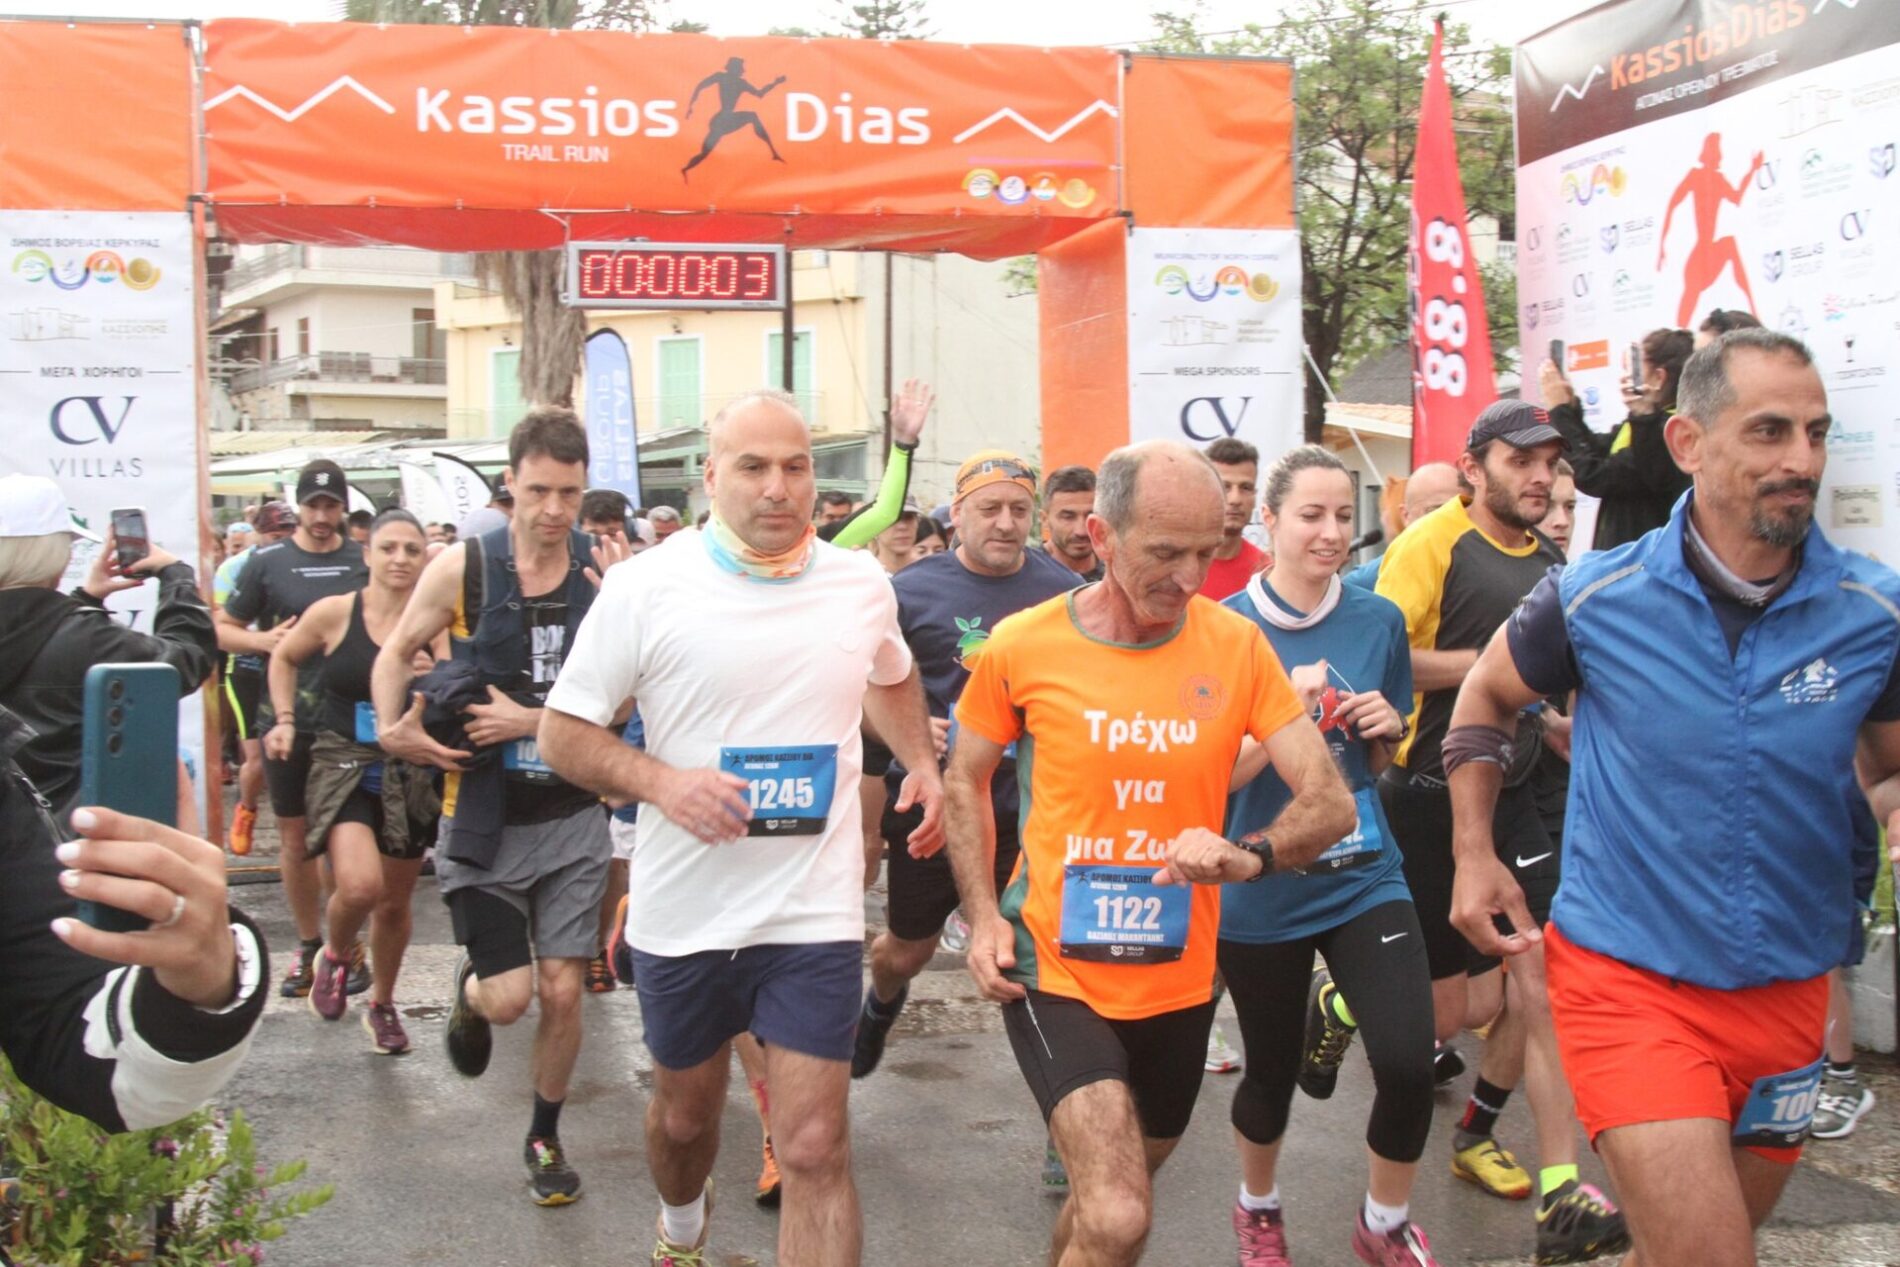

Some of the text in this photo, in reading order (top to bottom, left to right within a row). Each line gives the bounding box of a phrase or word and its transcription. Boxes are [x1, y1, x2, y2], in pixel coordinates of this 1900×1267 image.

[1611, 0, 1807, 91] Kassios Dias
[416, 85, 931, 145] Kassios Dias
[501, 143, 609, 163] TRAIL RUN
[582, 253, 770, 297] 00:00:03
[40, 366, 143, 378] ΜΕΓΑ ΧΟΡΗΓΟΙ
[1174, 366, 1261, 376] MEGA SPONSORS
[49, 395, 140, 446] CV
[1179, 396, 1254, 442] CV
[49, 457, 144, 478] VILLAS
[1083, 709, 1198, 753] Τρέχω
[748, 777, 815, 810] 1245
[1113, 779, 1167, 811] για
[1063, 834, 1115, 866] μια
[1093, 894, 1162, 930] 1122
